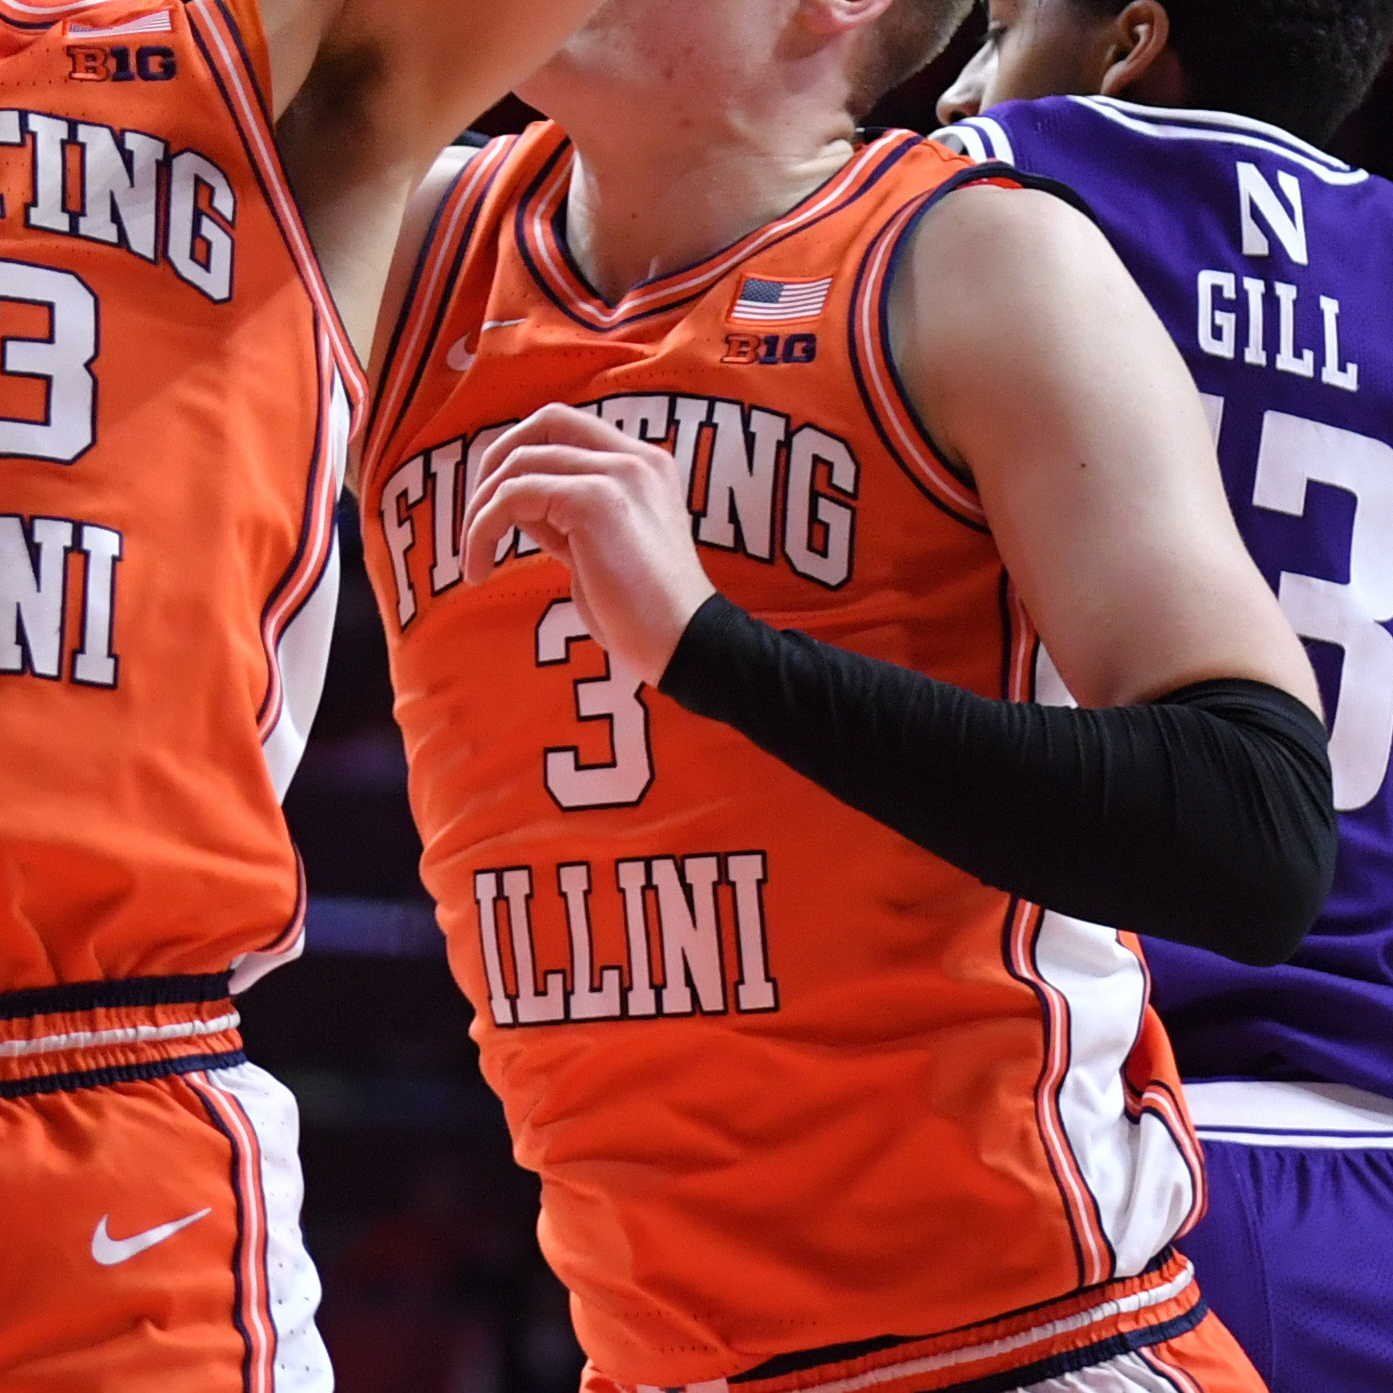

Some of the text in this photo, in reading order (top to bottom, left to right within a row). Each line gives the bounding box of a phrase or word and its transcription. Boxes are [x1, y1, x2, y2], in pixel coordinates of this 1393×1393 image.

[1235, 160, 1309, 266] N
[1197, 269, 1359, 392] GILL
[378, 390, 862, 634] FITING
[534, 598, 655, 812] 3
[472, 848, 781, 1029] ILLINI
